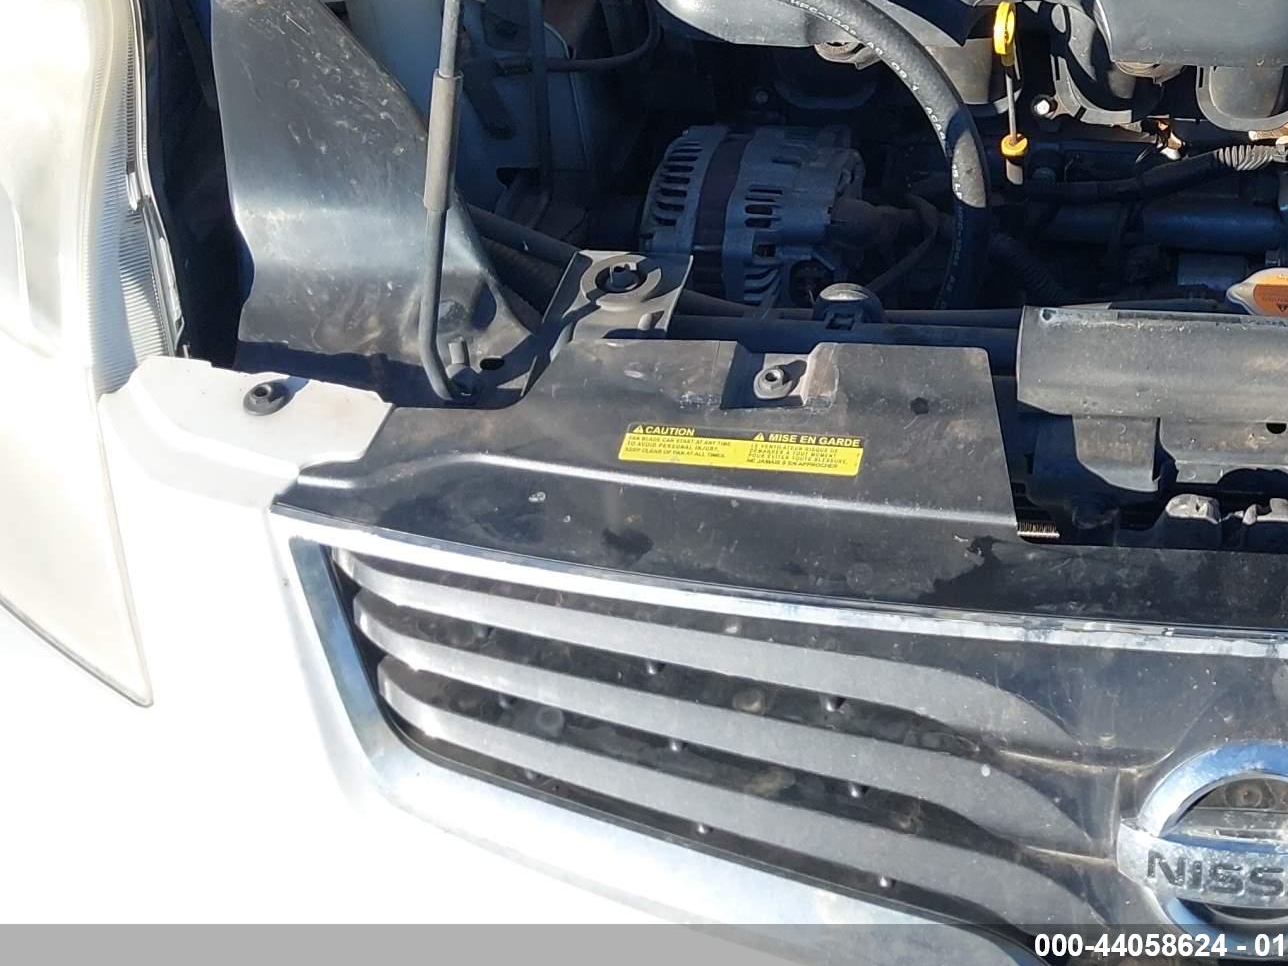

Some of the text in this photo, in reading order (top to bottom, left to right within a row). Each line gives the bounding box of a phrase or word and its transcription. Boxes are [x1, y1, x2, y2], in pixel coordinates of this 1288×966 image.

[645, 426, 695, 436] CAUTION
[768, 434, 860, 447] MISE EN GARDE
